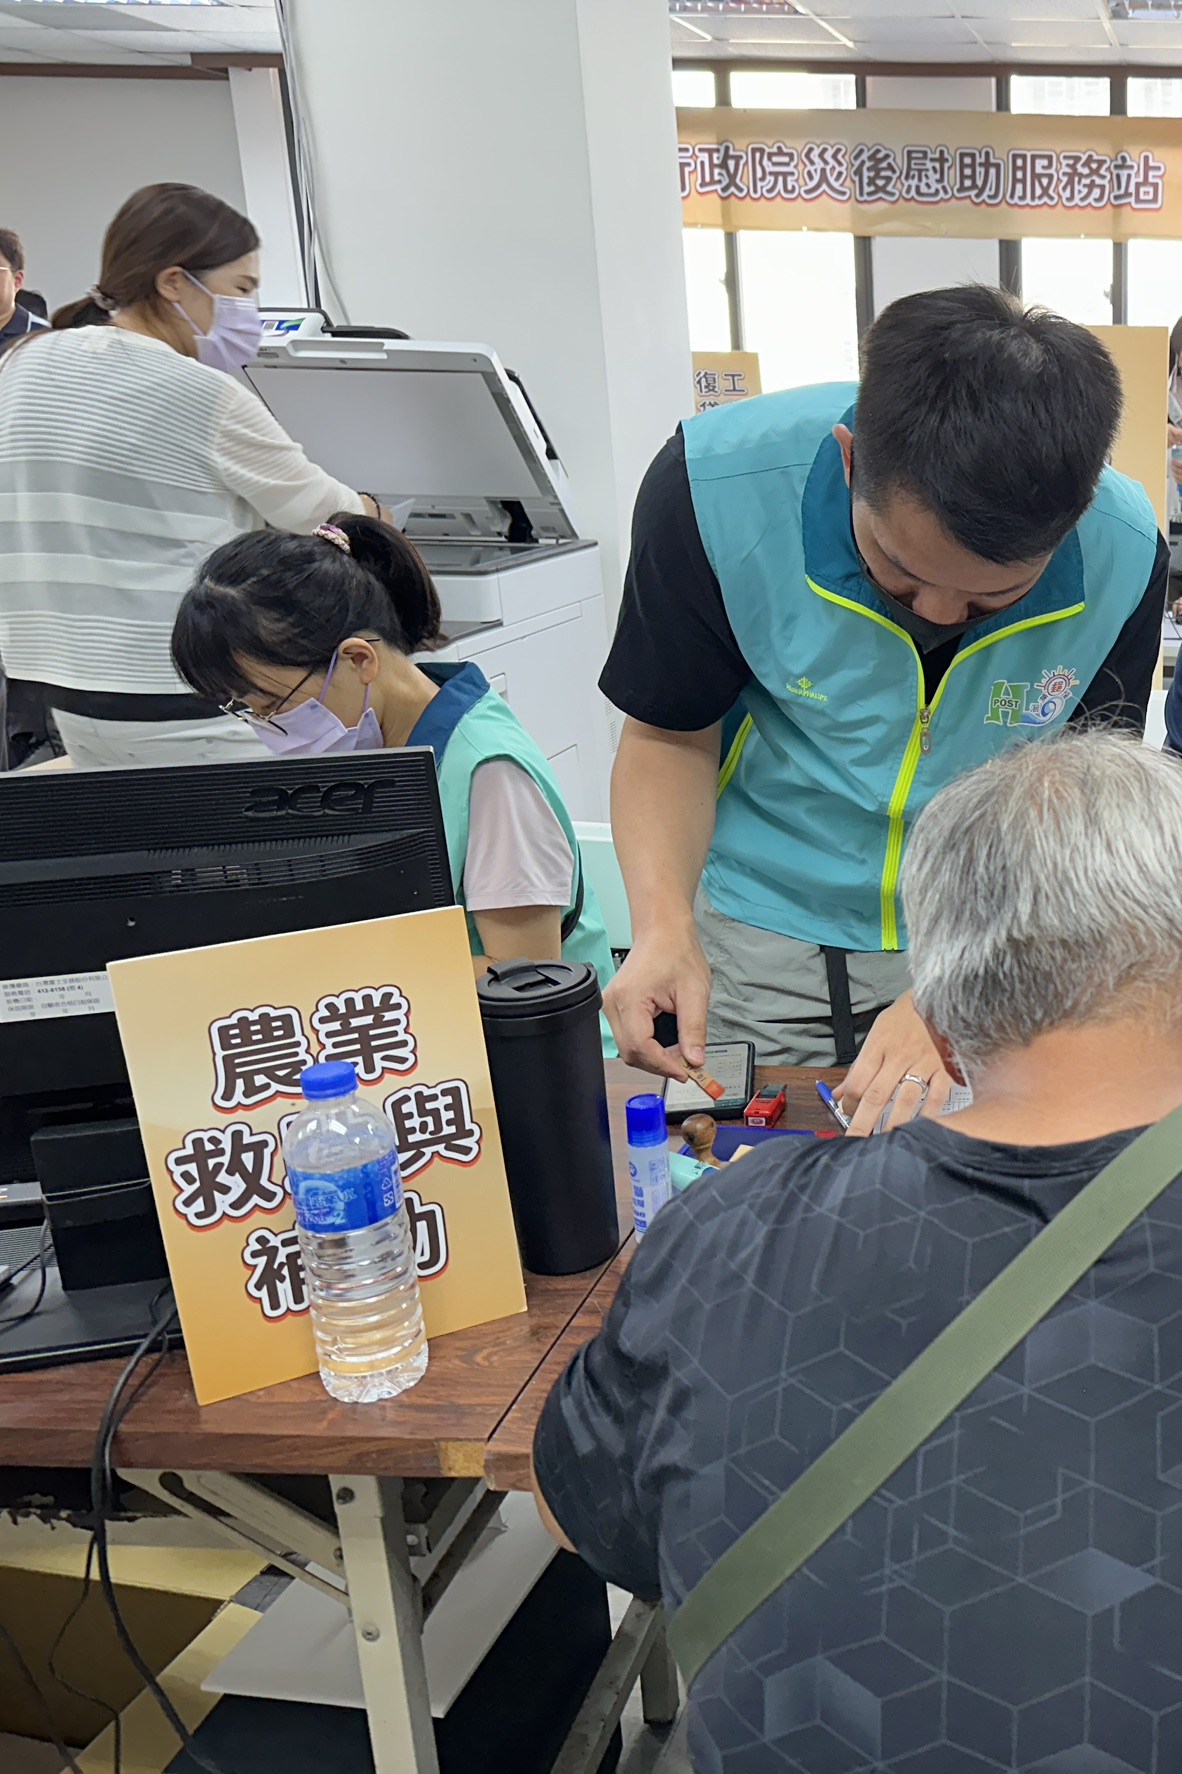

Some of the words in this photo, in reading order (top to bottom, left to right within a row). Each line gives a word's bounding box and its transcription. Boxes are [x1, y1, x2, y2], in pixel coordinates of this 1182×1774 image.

[695, 371, 747, 394] 復工
[993, 698, 1020, 709] POST
[243, 778, 396, 817] acer
[210, 985, 416, 1110] 農業
[167, 1078, 483, 1225] 救與
